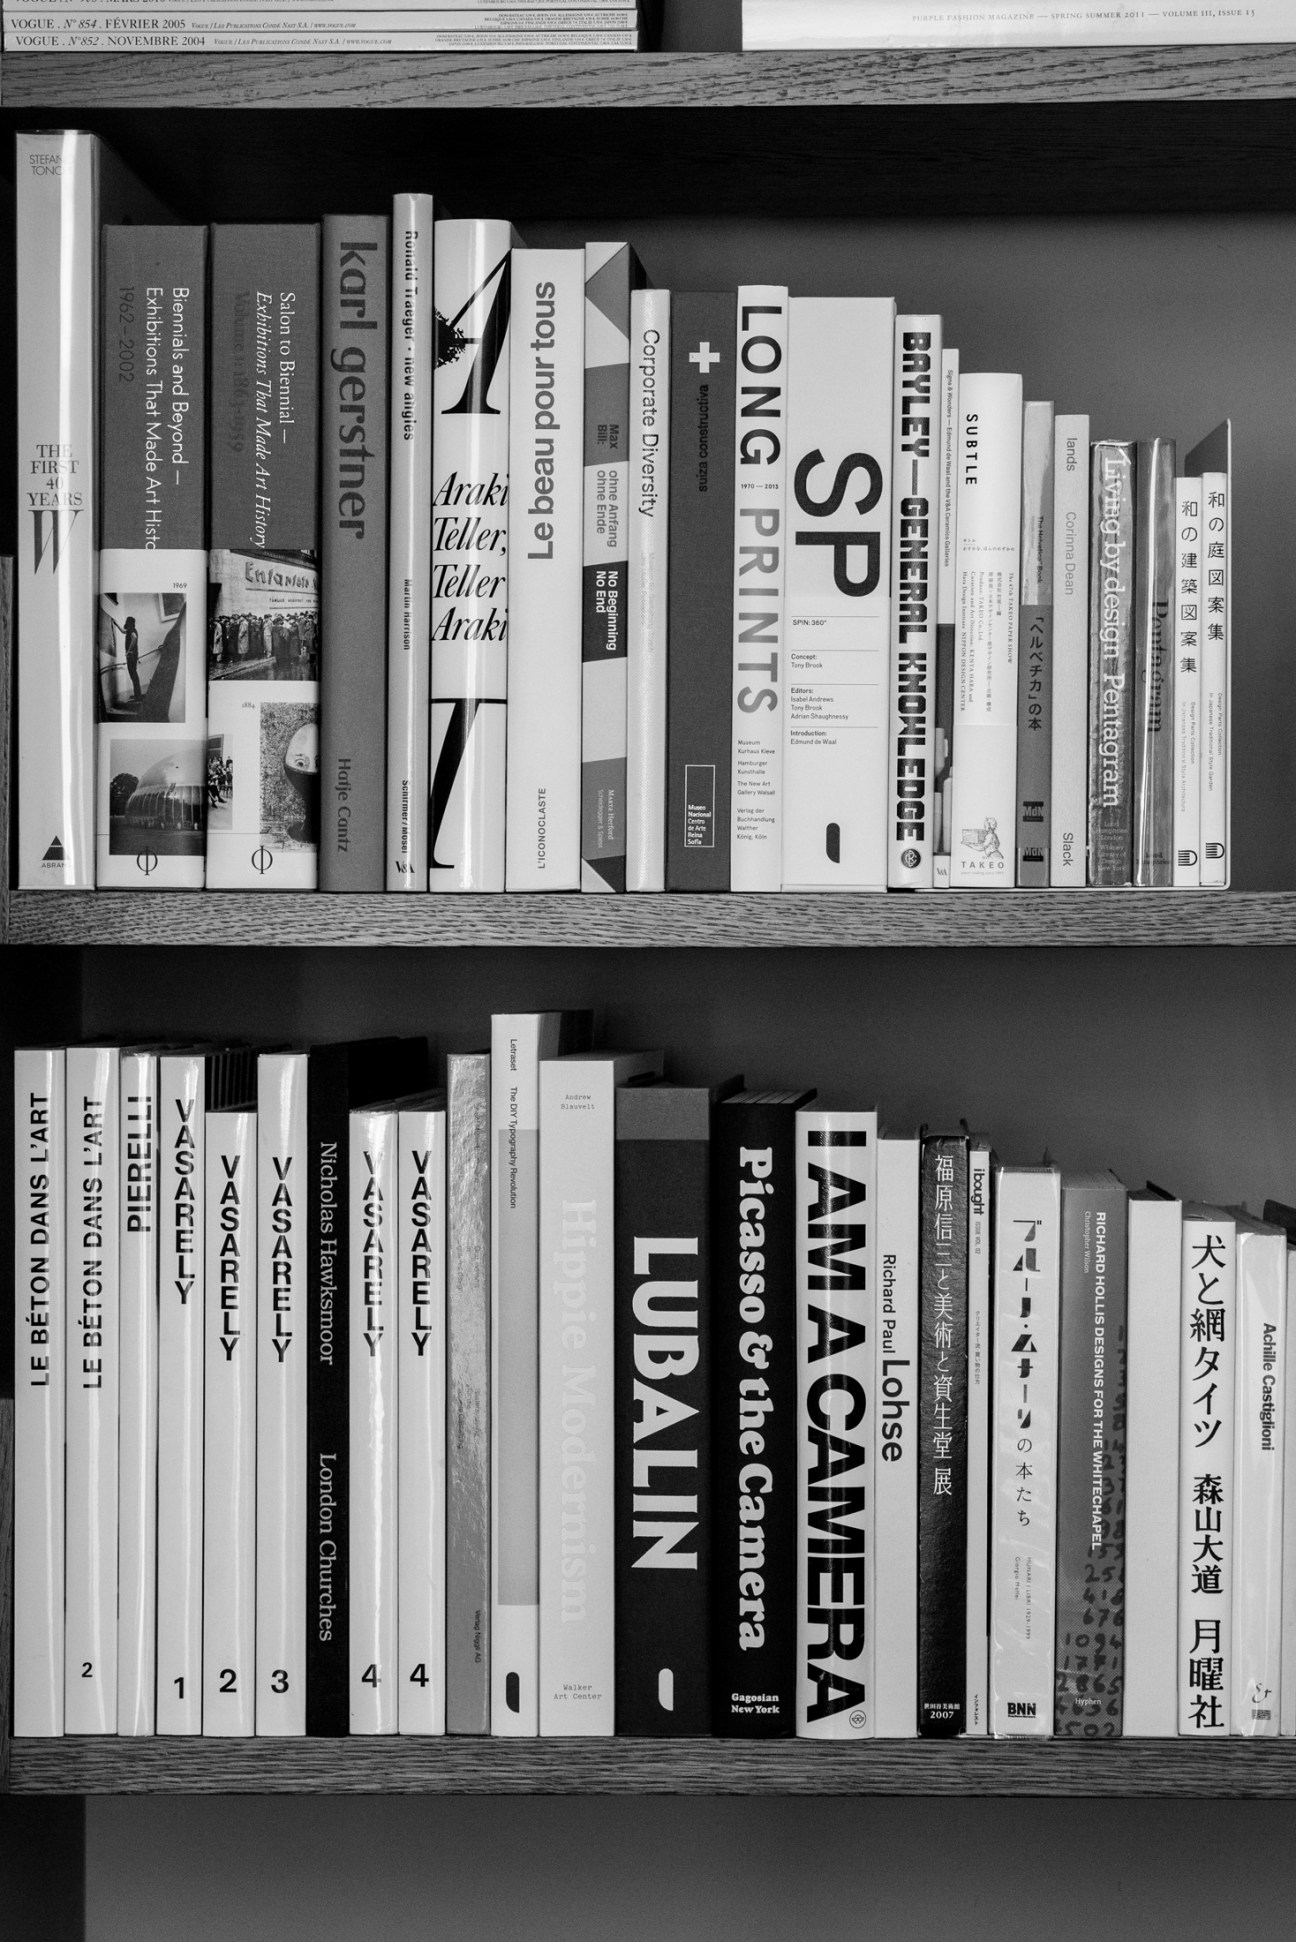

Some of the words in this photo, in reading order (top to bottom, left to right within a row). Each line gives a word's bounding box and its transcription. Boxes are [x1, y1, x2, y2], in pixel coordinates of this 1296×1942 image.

[12, 19, 54, 28] VOGUE
[79, 20, 97, 28] 854
[106, 17, 158, 28] FÉVRIER
[163, 20, 185, 28] 2005
[16, 37, 58, 45] VOGUE
[108, 37, 178, 45] NOVEMBRE
[182, 37, 204, 45] 2004
[404, 230, 419, 281] Ronald
[338, 241, 378, 330] karl
[146, 288, 163, 375] Exhibitions
[173, 288, 189, 359] Biennials
[257, 292, 272, 374] Exhibitions
[280, 293, 295, 334] Salon
[402, 287, 417, 339] Traeger
[531, 282, 555, 351] tous
[281, 342, 294, 354] to
[404, 357, 417, 386] new
[146, 380, 162, 414] That
[173, 365, 186, 395] and
[257, 381, 271, 412] That
[280, 361, 295, 423] Biennial
[535, 357, 560, 429] pour
[639, 330, 660, 426] Corporate
[740, 306, 782, 465] LONG
[146, 423, 163, 471] Made
[171, 402, 189, 463] Beyond
[256, 418, 271, 459] Made
[331, 345, 378, 540] gerstner
[610, 425, 619, 449] Max
[698, 384, 709, 459] constructiva
[31, 461, 76, 474] FIRST
[36, 445, 73, 458] THE
[966, 414, 978, 484] SUBTLE
[1067, 438, 1077, 471] lands
[27, 493, 81, 506] YEARS
[46, 477, 64, 489] 40
[146, 477, 161, 504] Art
[256, 466, 270, 490] Art
[433, 470, 509, 508] Araki
[528, 439, 554, 514] beau
[596, 469, 606, 499] ohne
[608, 469, 618, 499] ohne
[639, 434, 659, 517] Diversity
[696, 461, 708, 492] suiza
[1101, 449, 1131, 534] Living
[28, 510, 83, 574] W
[250, 497, 270, 548] History
[434, 517, 506, 555] Teller,
[528, 522, 553, 559] Le
[597, 505, 606, 533] Ende
[606, 503, 619, 549] Anfang
[794, 449, 883, 597] SP
[1066, 512, 1076, 559] Corinna
[432, 563, 506, 599] Teller
[596, 571, 606, 587] No
[608, 571, 618, 587] No
[1065, 564, 1076, 595] Dean
[1100, 541, 1126, 573] by
[1208, 489, 1227, 642] 和の庭図案集
[596, 591, 606, 612] End
[737, 509, 779, 713] PRINTS
[1181, 501, 1197, 672] 和の建築図案集
[431, 605, 508, 642] Araki
[604, 591, 618, 650] Beginning
[1100, 577, 1125, 659] design
[1028, 617, 1044, 731] 「ヘルベチカ」の本
[897, 653, 926, 841] KNOWLEDGE
[1099, 672, 1125, 807] Pentagram
[337, 757, 352, 801] Hatje
[337, 804, 352, 853] Cantz
[1063, 833, 1074, 866] Slack
[31, 1093, 47, 1162] L'ART
[84, 1096, 102, 1165] L'ART
[509, 1120, 517, 1166] Typography
[808, 1131, 866, 1146] I
[127, 1097, 151, 1232] PIERELLI
[321, 1143, 337, 1233] Nicholas
[30, 1175, 47, 1244] DANS
[83, 1179, 102, 1247] DANS
[175, 1099, 195, 1304] VASARELY
[808, 1163, 866, 1290] AM
[363, 1151, 383, 1356] VASARELY
[411, 1151, 431, 1356] VASARELY
[740, 1147, 774, 1323] Picasso
[1083, 1211, 1091, 1249] Christopher
[1096, 1212, 1106, 1273] RICHARD
[220, 1155, 240, 1361] VASARELY
[272, 1157, 292, 1362] VASARELY
[553, 1200, 596, 1352] Hippie
[883, 1255, 896, 1313] Richard
[26, 1258, 49, 1344] BÉTON
[78, 1261, 102, 1346] BÉTON
[320, 1239, 337, 1365] Hawksmoor
[1095, 1276, 1105, 1324] HOLLIS
[739, 1331, 773, 1369] &
[808, 1304, 865, 1363] A
[883, 1320, 896, 1353] Paul
[1094, 1328, 1104, 1391] DESIGNS
[1190, 1235, 1226, 1447] 犬と網タイツ
[1263, 1323, 1276, 1371] Achille
[31, 1357, 47, 1385] LE
[83, 1359, 101, 1388] LE
[632, 1237, 699, 1569] LUBALIN
[739, 1378, 774, 1454] the
[882, 1360, 910, 1461] Lohse
[1094, 1390, 1103, 1418] FOR
[1260, 1375, 1275, 1450] Castiglioni
[1094, 1421, 1103, 1448] THE
[320, 1454, 336, 1533] London
[558, 1366, 596, 1623] Modernism
[1092, 1451, 1102, 1550] WHITECHAPEL
[739, 1463, 773, 1650] Camera
[807, 1374, 866, 1723] CAMERA
[1192, 1474, 1224, 1594] 森山大道
[320, 1540, 336, 1641] Churches
[82, 1662, 92, 1677] 2
[174, 1677, 184, 1699] 1
[220, 1669, 236, 1692] 2
[271, 1670, 289, 1693] 3
[361, 1664, 382, 1688] 4
[410, 1664, 429, 1687] 4
[1188, 1620, 1224, 1728] 月曜社
[732, 1693, 779, 1703] Gagosian
[732, 1705, 754, 1713] New
[1008, 1703, 1035, 1715] BNN
[1076, 1698, 1101, 1706] Hyphen
